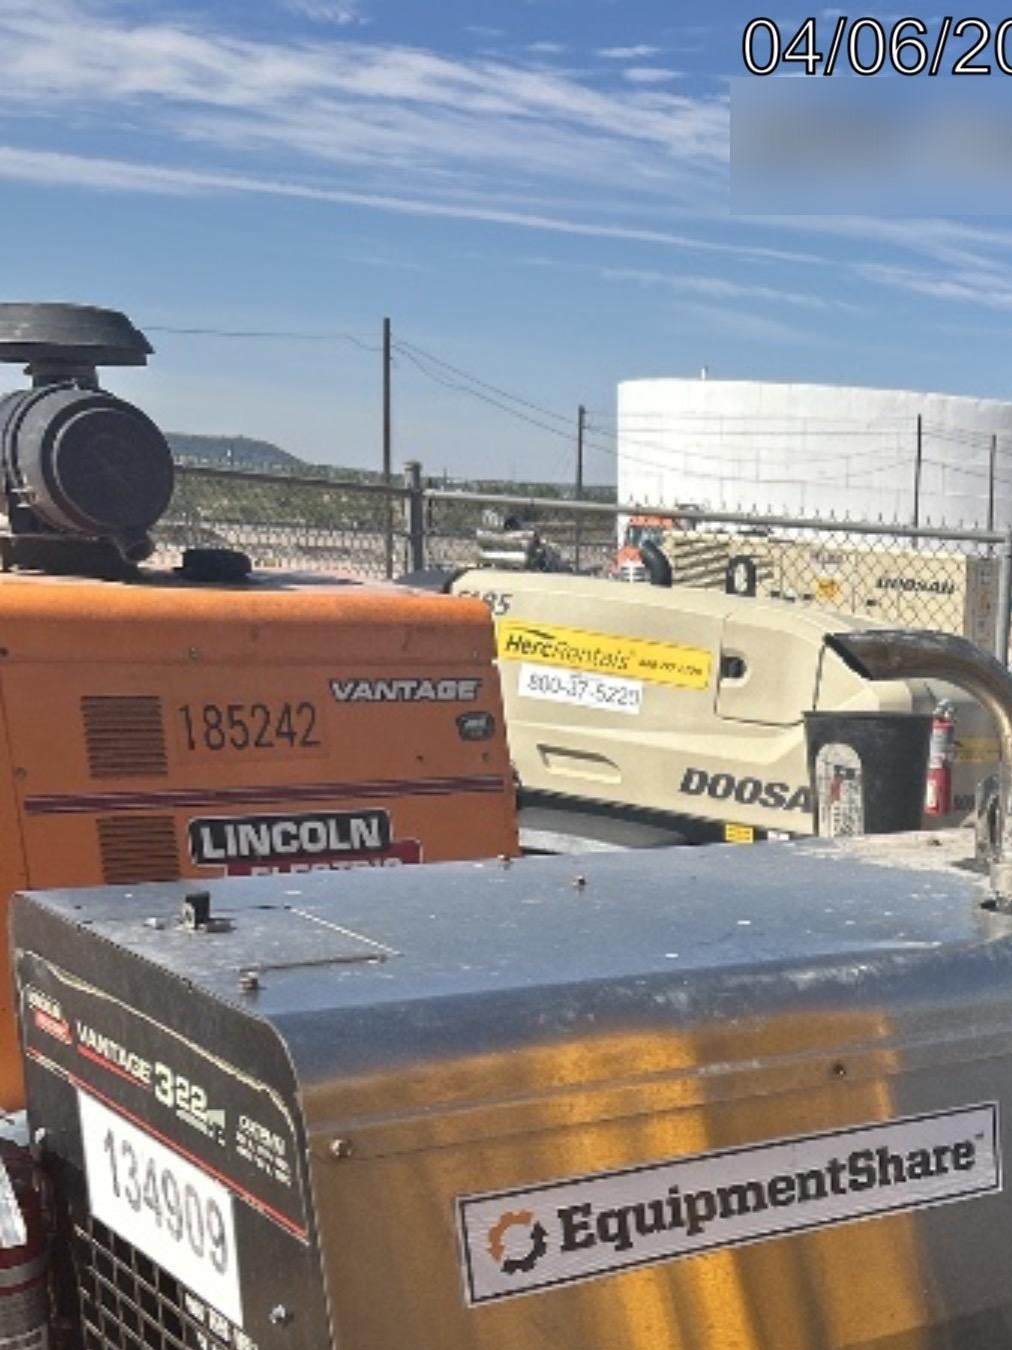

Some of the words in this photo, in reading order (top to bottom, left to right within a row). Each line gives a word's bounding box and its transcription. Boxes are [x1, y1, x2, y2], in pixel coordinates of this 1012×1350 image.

[331, 679, 481, 701] VANTAGE
[179, 701, 321, 750] 185242
[680, 768, 813, 813] DOOSA
[200, 817, 382, 859] LINCOLN
[75, 1020, 152, 1085] VANTAGE
[154, 1061, 208, 1117] 322
[104, 1128, 229, 1276] 134909
[557, 1137, 978, 1253] EquipmentShare
